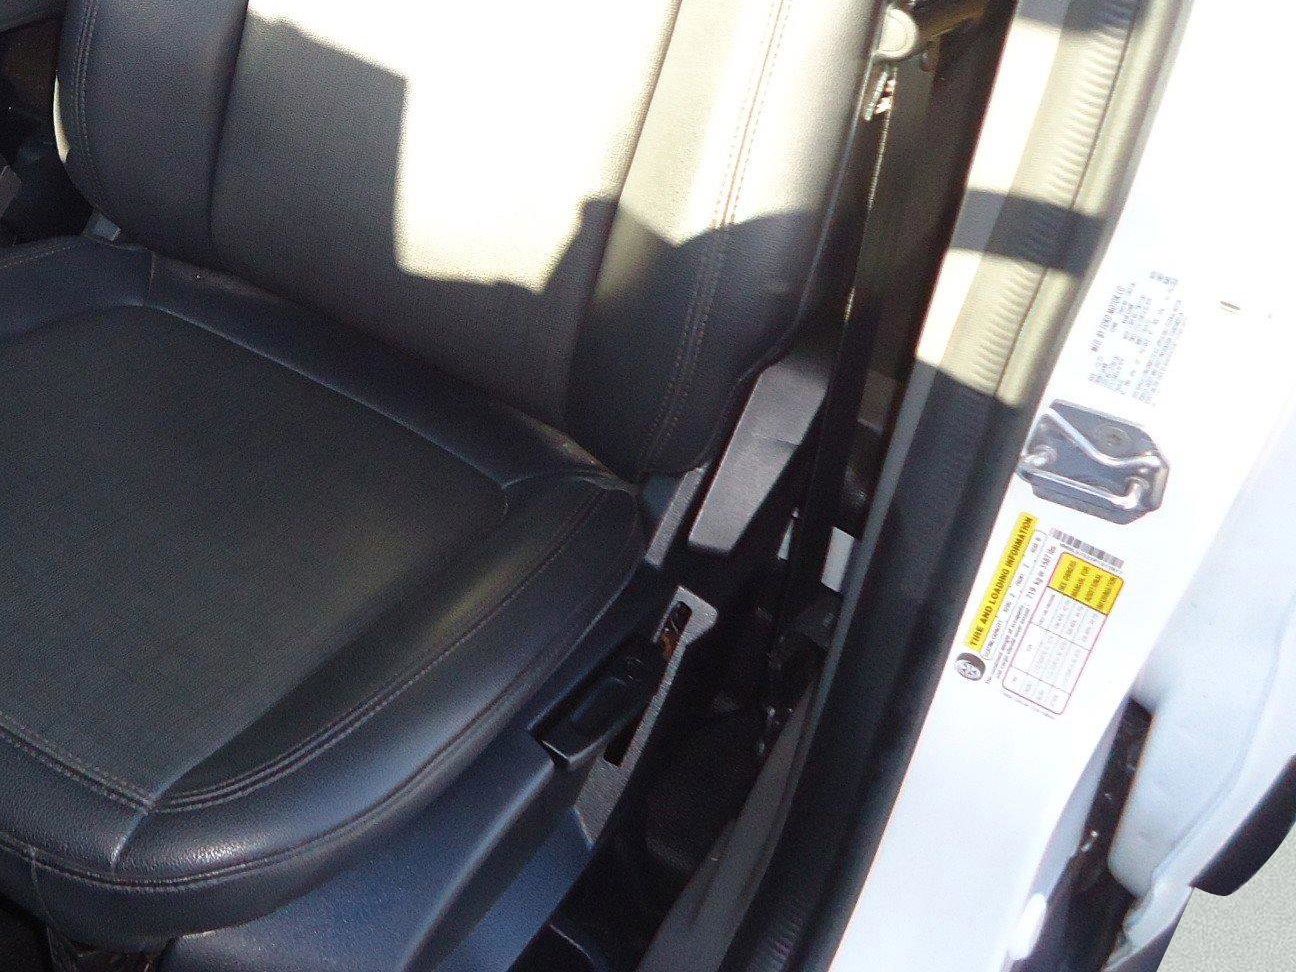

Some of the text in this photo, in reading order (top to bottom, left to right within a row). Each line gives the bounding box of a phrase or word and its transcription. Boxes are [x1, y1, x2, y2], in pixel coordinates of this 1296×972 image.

[969, 625, 984, 646] TIRE
[978, 604, 993, 624] AND
[987, 567, 1010, 605] LOADING
[1003, 515, 1033, 567] INFORMATION
